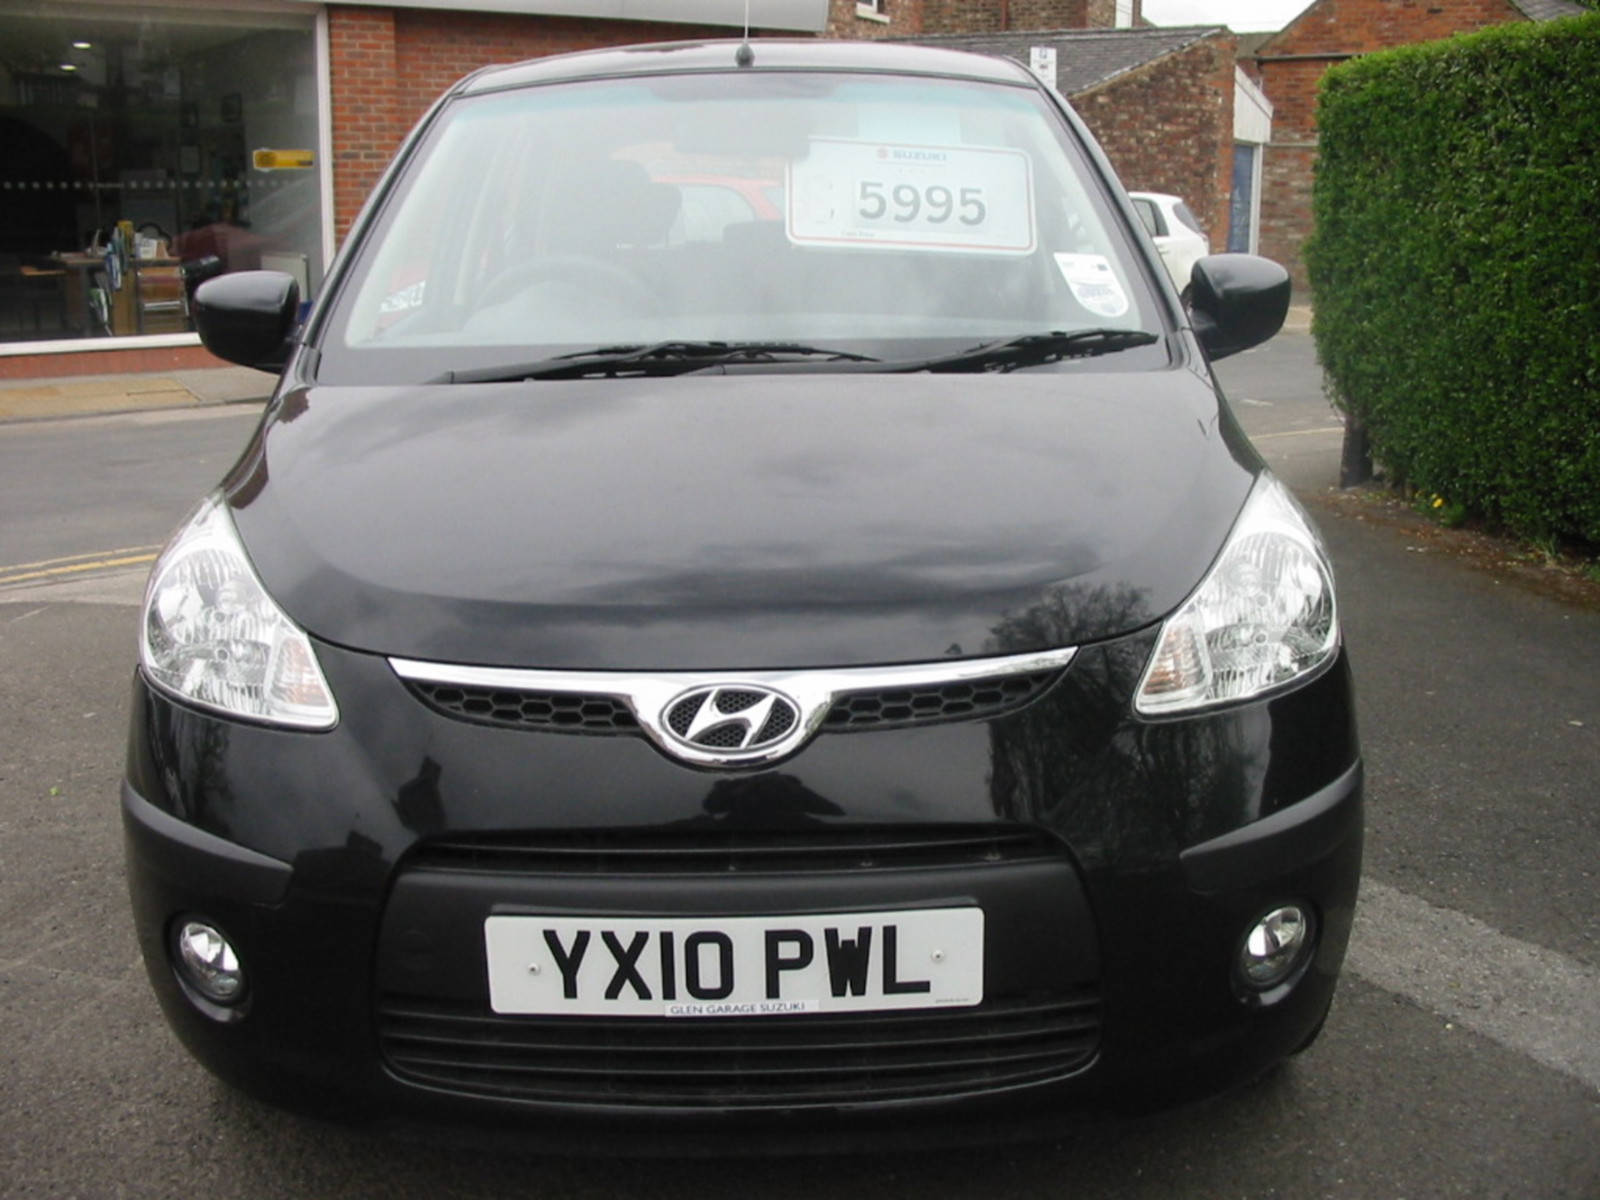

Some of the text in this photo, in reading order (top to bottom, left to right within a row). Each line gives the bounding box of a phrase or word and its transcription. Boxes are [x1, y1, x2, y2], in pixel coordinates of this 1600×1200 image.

[858, 181, 987, 226] 5995
[543, 925, 931, 1001] YX10 PWL
[670, 1001, 806, 1015] GLEN GARAGE SUZUKI
